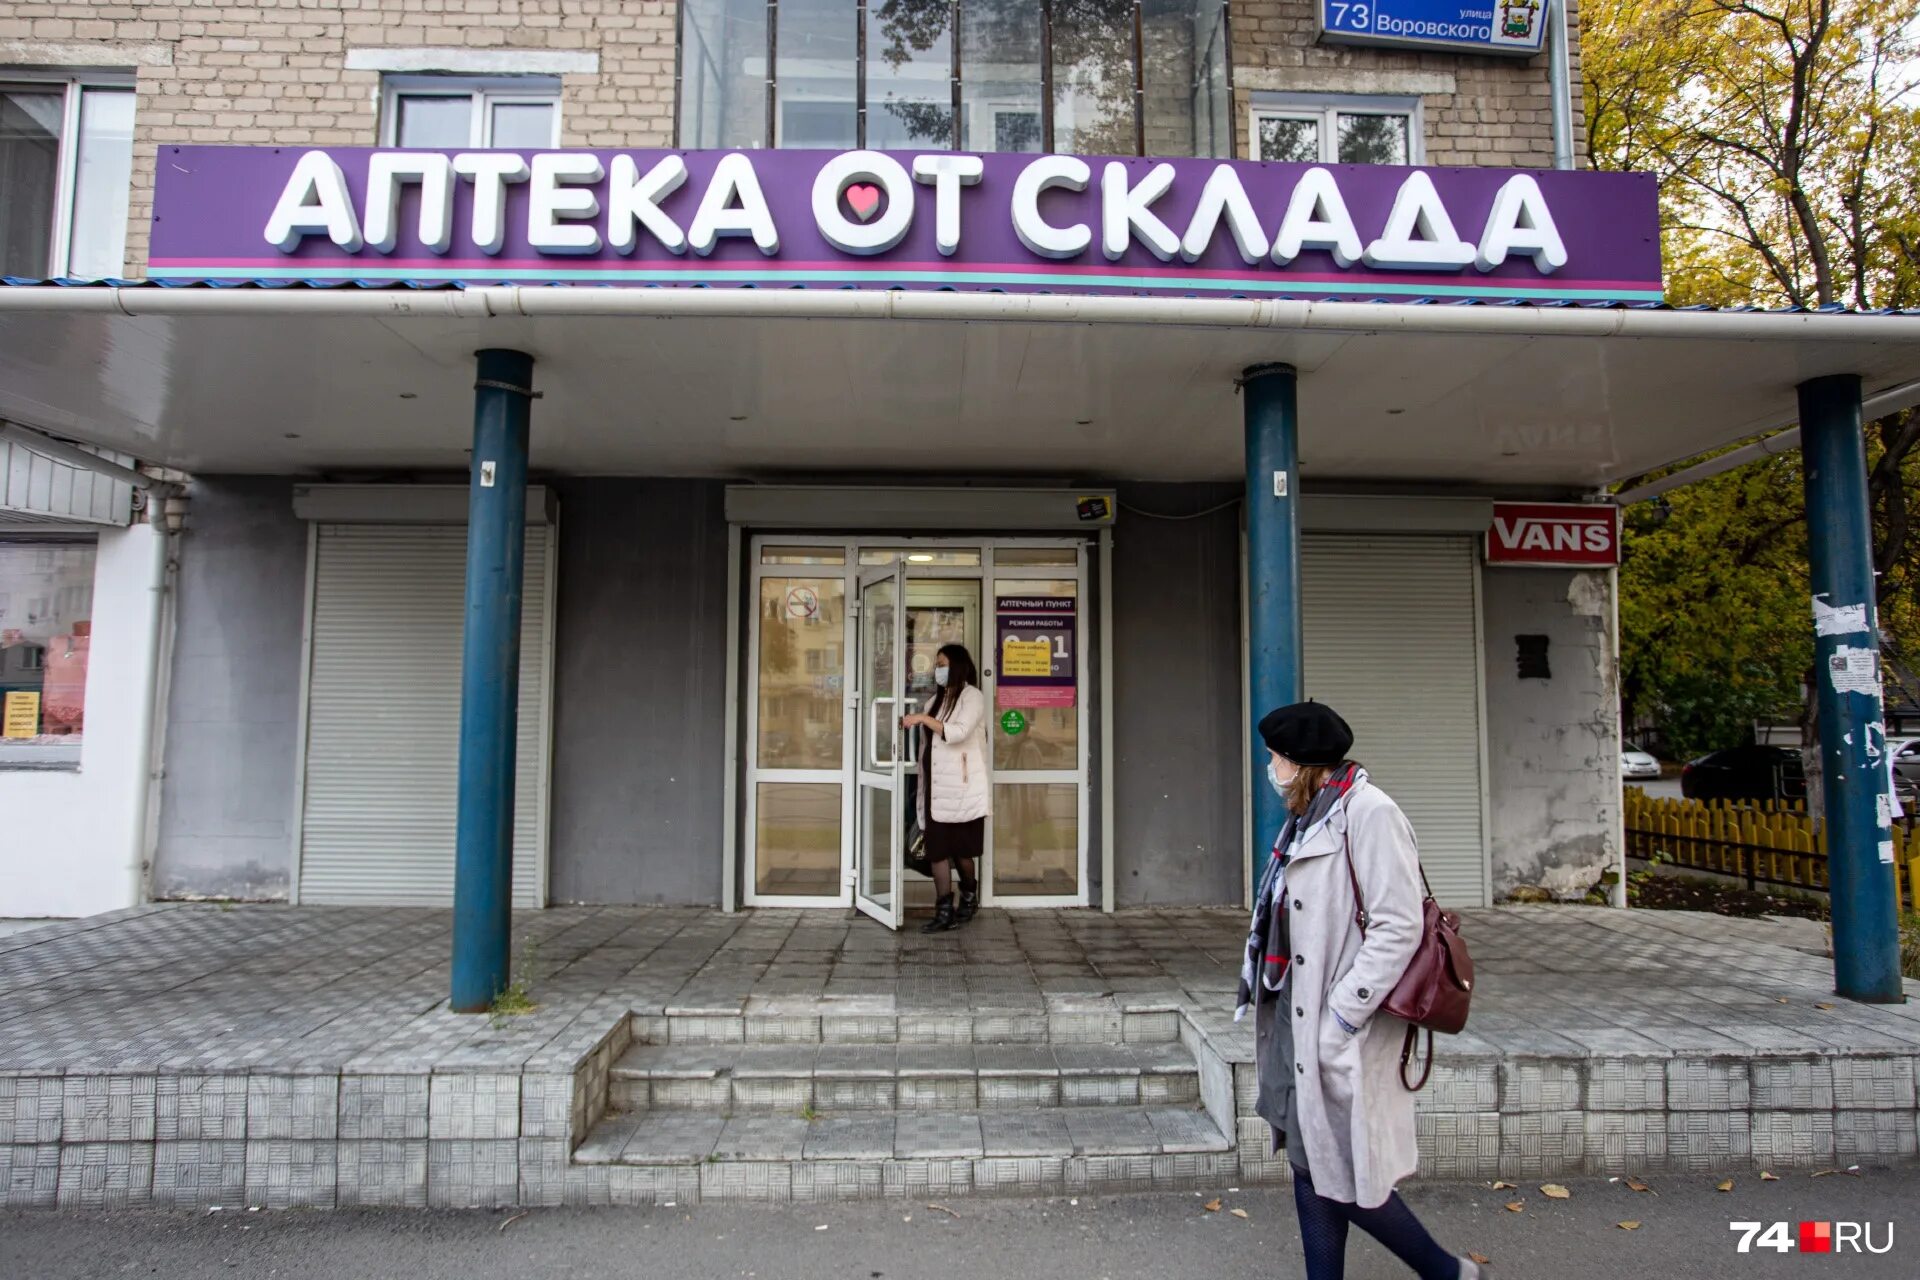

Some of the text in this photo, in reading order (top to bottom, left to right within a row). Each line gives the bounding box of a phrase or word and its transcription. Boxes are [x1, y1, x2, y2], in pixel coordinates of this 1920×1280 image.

[1330, 2, 1370, 29] 73
[1376, 14, 1490, 40] Воровского
[1459, 8, 1492, 20] улица
[264, 149, 1568, 276] АПТЕКА ОТ СКЛАДА
[1494, 517, 1611, 552] VANS
[1000, 599, 1072, 608] АПТЕЧНЫЙ ПУНКТ
[1009, 619, 1064, 627] РЕЖИМ РАБОТЫ
